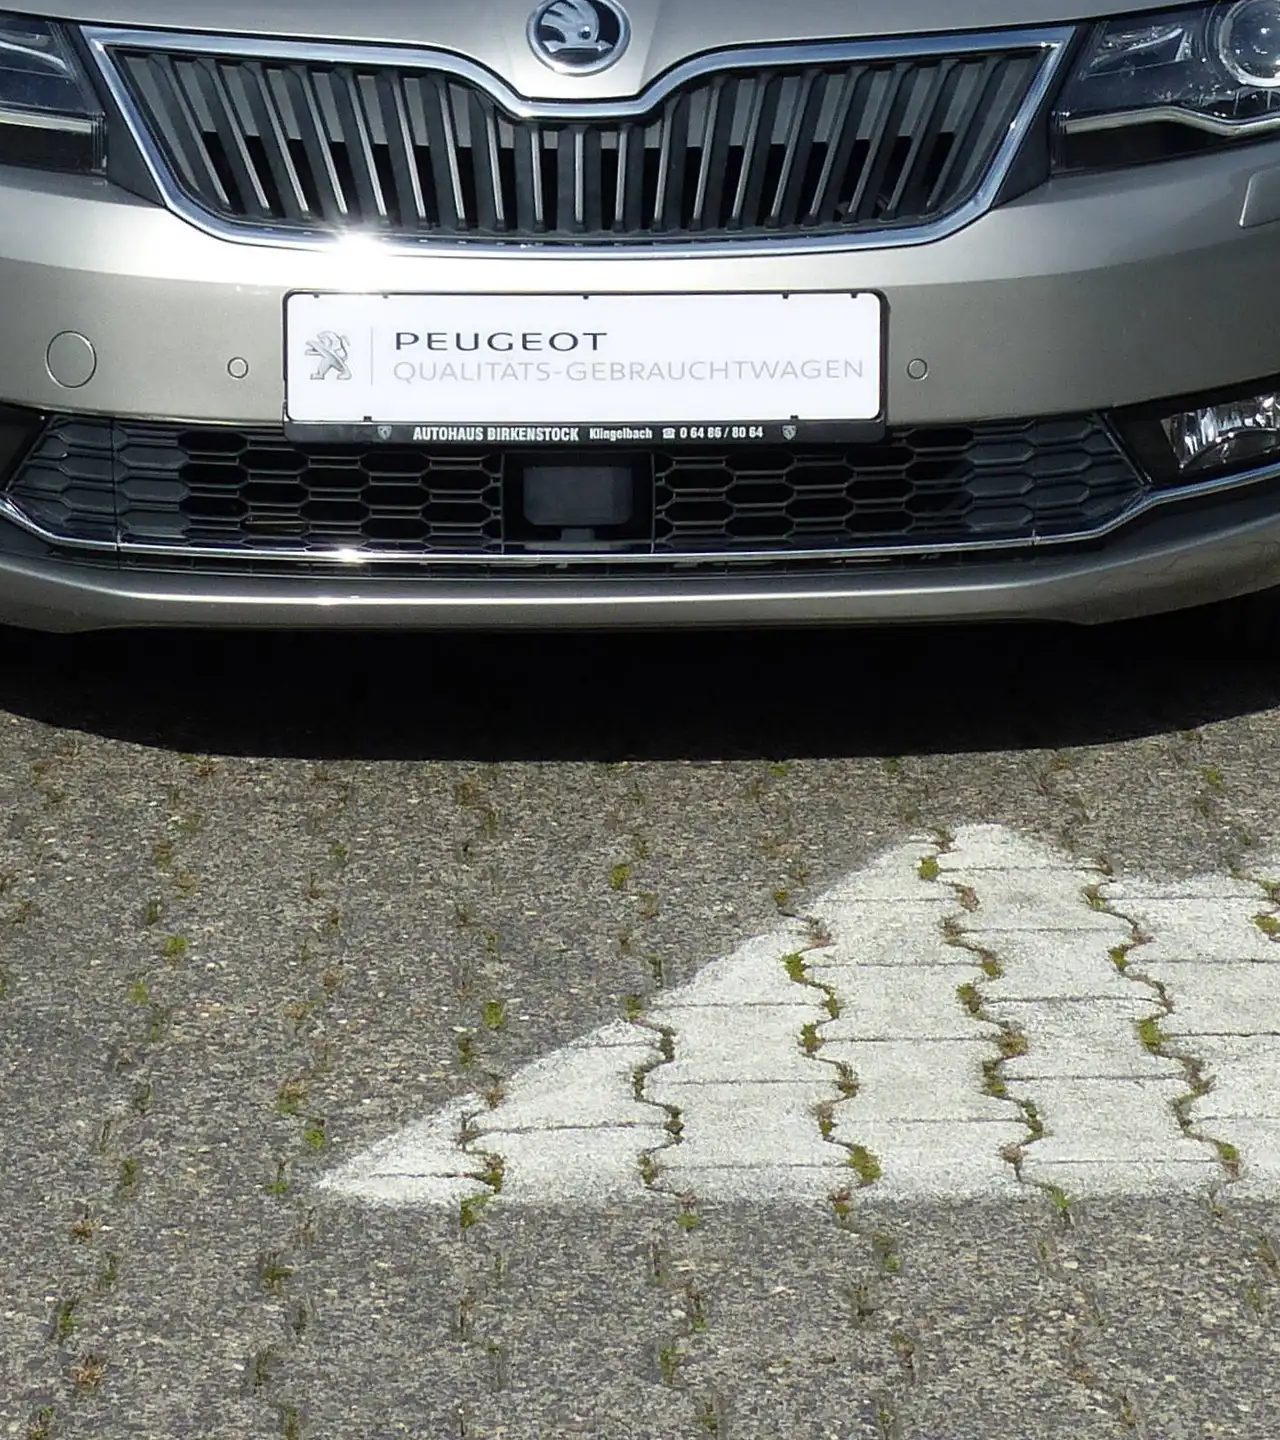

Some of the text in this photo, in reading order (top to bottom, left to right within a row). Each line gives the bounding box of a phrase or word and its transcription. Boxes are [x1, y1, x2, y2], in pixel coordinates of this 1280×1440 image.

[395, 332, 608, 353] PEUGEOT
[393, 357, 864, 384] QUALITÄTS-GEBRAUCHTWAGEN
[412, 426, 484, 442] AUTOHAUS
[487, 426, 580, 442] BIRKENSTOCK
[589, 427, 653, 442] Klingelbach
[679, 426, 688, 439] 0
[690, 426, 705, 439] 64
